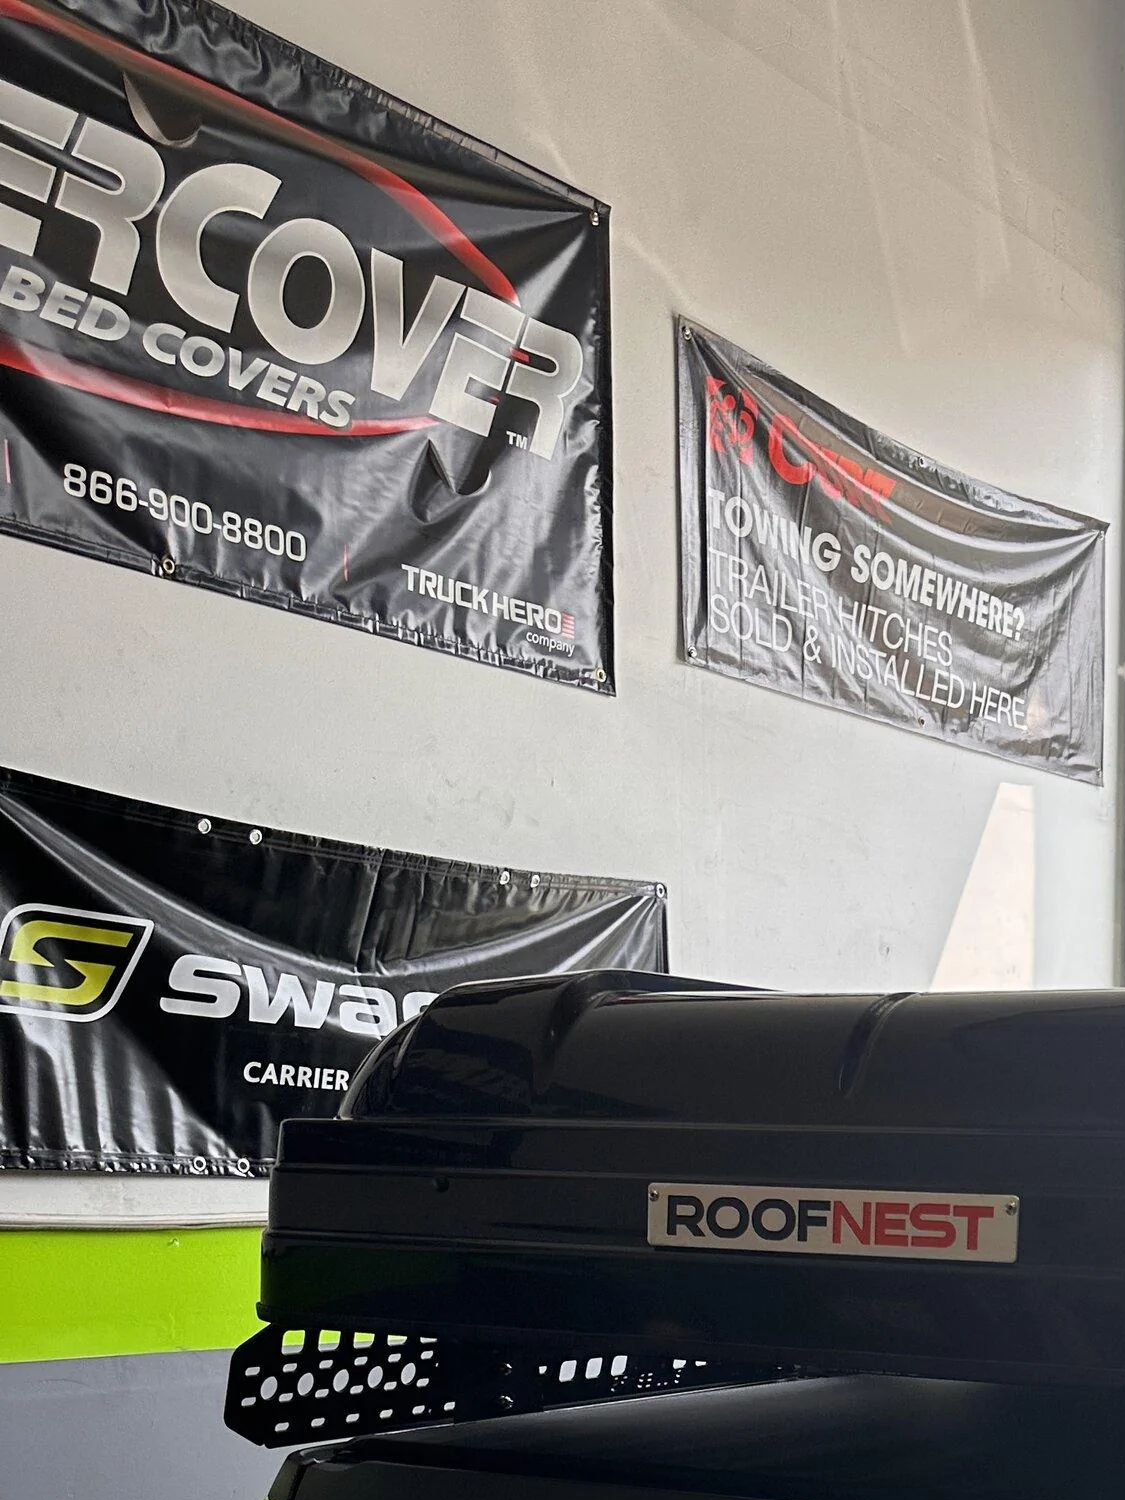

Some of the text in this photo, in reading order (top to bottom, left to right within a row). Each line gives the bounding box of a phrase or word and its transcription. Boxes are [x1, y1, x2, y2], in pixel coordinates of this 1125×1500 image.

[0, 265, 356, 429] BED COVERS
[63, 462, 307, 562] 866-900-8800
[401, 563, 562, 635] TRUCK HERO
[708, 489, 1026, 642] TOWING SOMEWHERE?
[709, 547, 954, 667] TRAILER HITCHES
[525, 630, 576, 658] company
[710, 595, 1029, 732] SOLD & INSTALLED HERE
[243, 1061, 350, 1091] CARRIER
[666, 1194, 995, 1251] ROOFNEST
